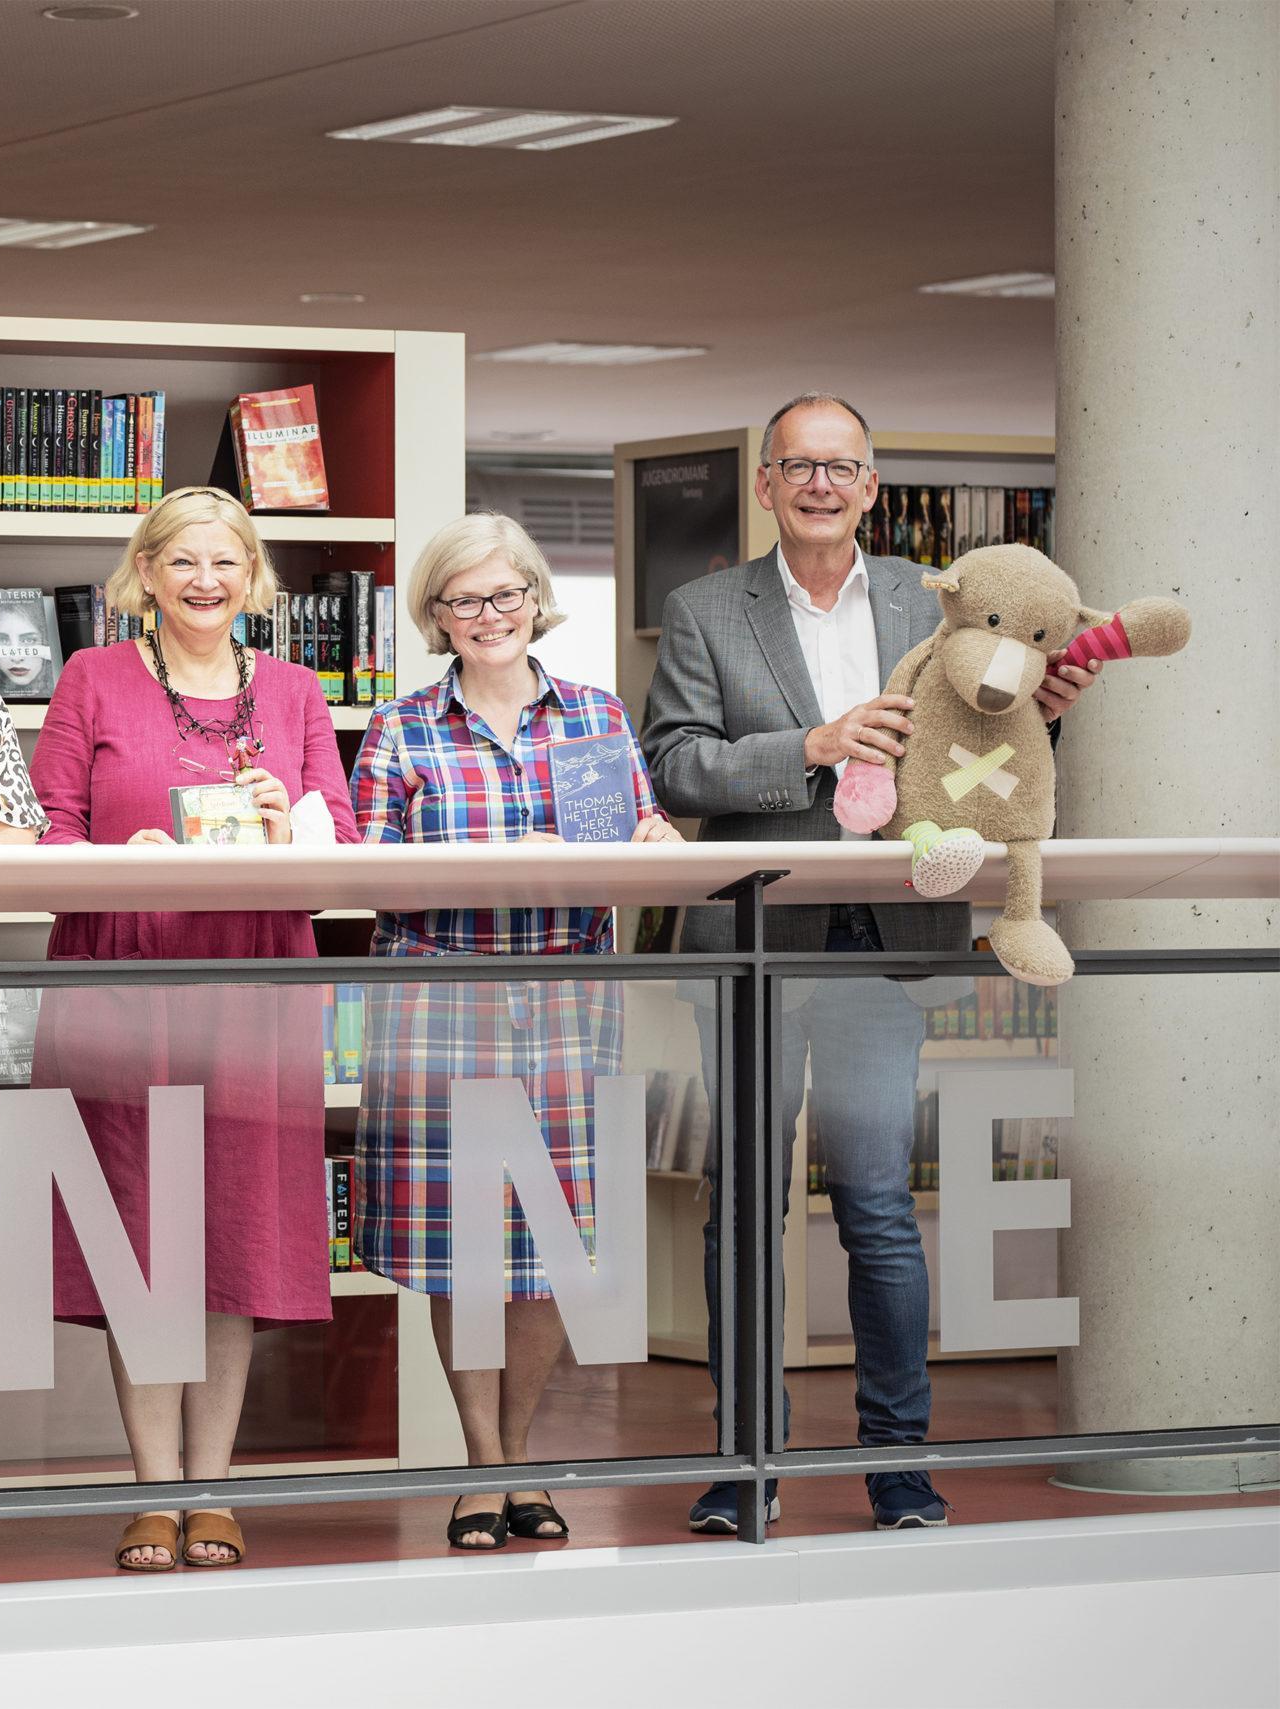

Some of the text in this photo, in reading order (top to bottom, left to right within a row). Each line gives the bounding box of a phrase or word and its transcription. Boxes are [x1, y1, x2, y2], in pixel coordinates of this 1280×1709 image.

[6, 399, 14, 443] UNTAMED
[67, 397, 77, 440] CHOSEN
[81, 409, 89, 437] BURNED
[247, 425, 318, 441] ILLUMINAE
[641, 463, 710, 487] JUGENDROMANE
[6, 590, 43, 600] TERRY
[565, 791, 624, 812] THOMAS
[563, 802, 627, 824] HETTCHE
[580, 816, 614, 832] HERZ
[576, 827, 620, 843] FADEN
[336, 1173, 347, 1231] FATED
